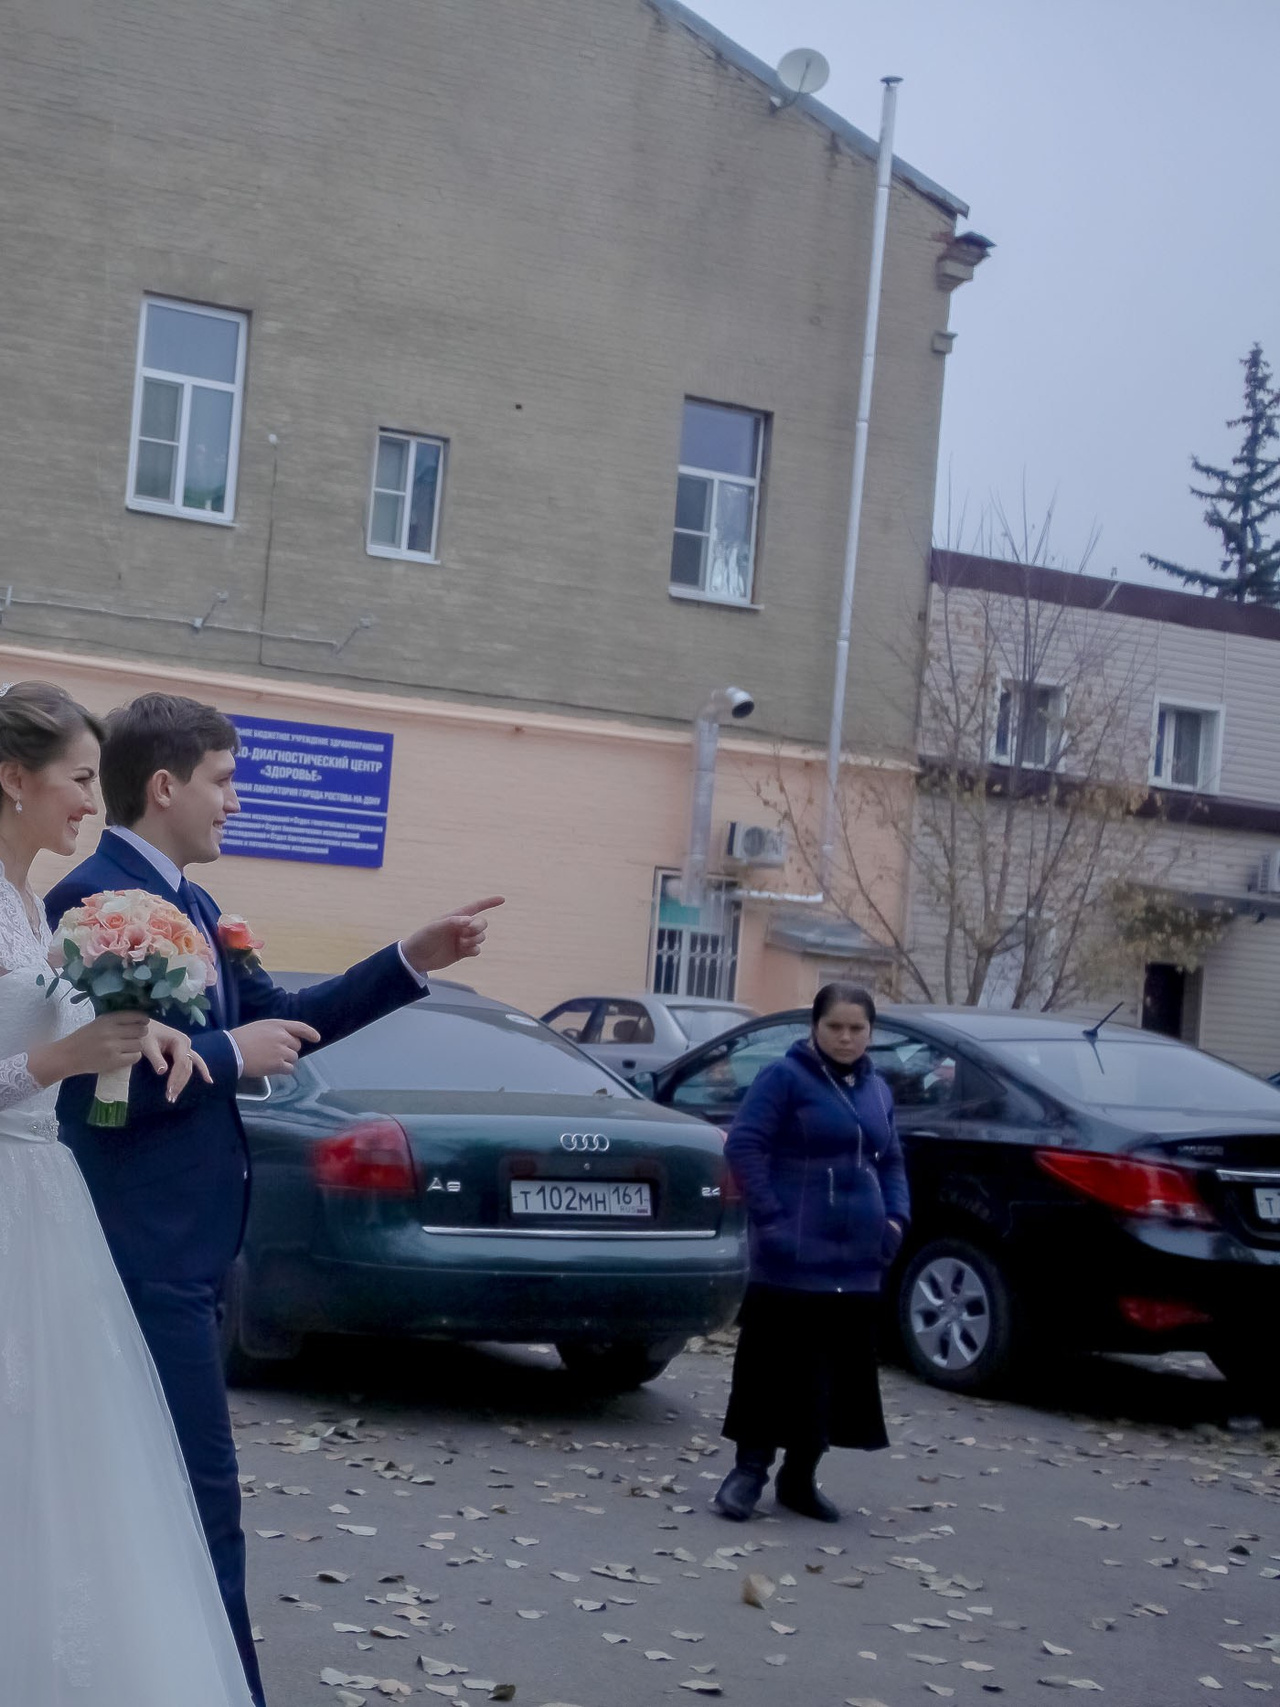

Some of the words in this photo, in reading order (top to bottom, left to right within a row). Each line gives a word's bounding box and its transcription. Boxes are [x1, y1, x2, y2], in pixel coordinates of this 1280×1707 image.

[260, 765, 322, 782] «ЗДОРОВЬЕ»
[350, 759, 383, 773] ЦЕНТР
[519, 1185, 607, 1212] Т102МН
[612, 1185, 644, 1205] 161
